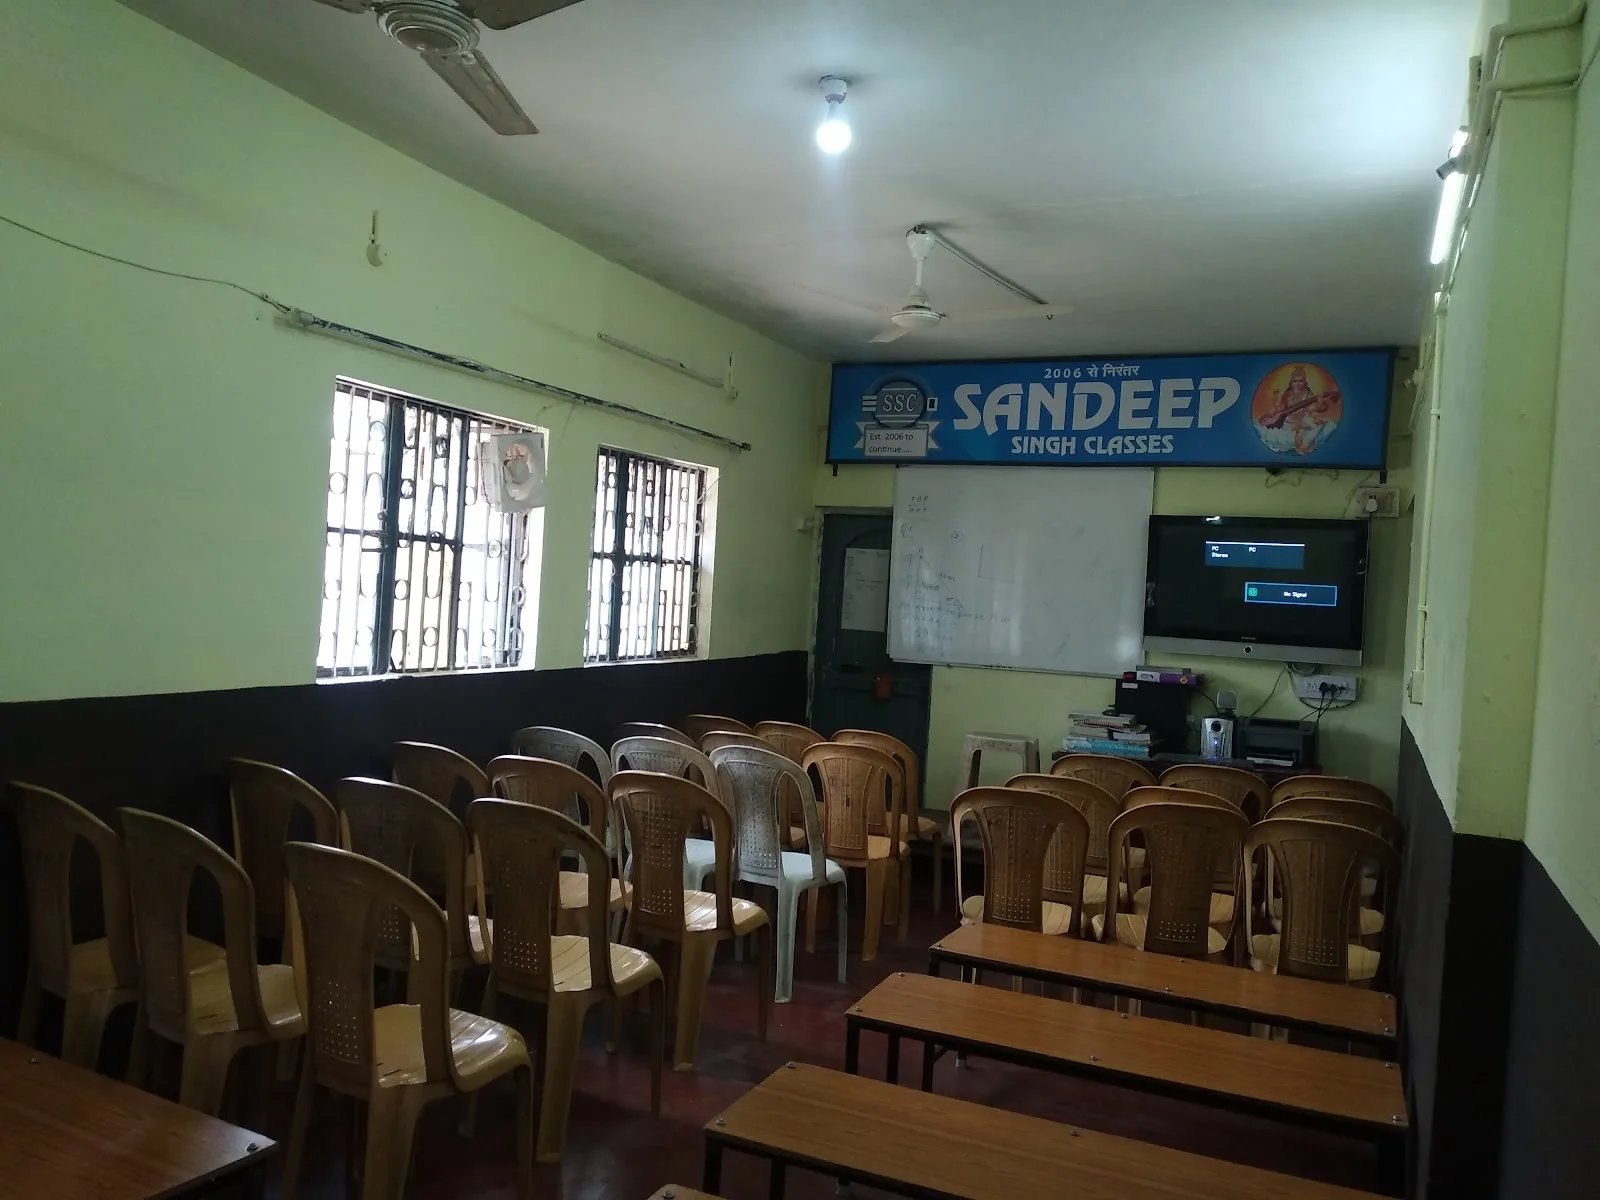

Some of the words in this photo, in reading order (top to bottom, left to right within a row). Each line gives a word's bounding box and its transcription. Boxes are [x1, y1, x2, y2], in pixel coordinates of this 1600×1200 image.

[1044, 367, 1082, 379] 2006
[1087, 364, 1099, 378] से
[1103, 362, 1140, 378] निरंतर
[882, 394, 917, 412] SSC
[953, 376, 1241, 436] SANDEEP
[885, 432, 904, 441] 2006
[905, 433, 914, 441] to
[1011, 435, 1076, 456] SINGH
[1084, 434, 1174, 456] CLASSES
[1292, 591, 1308, 599] Signal
